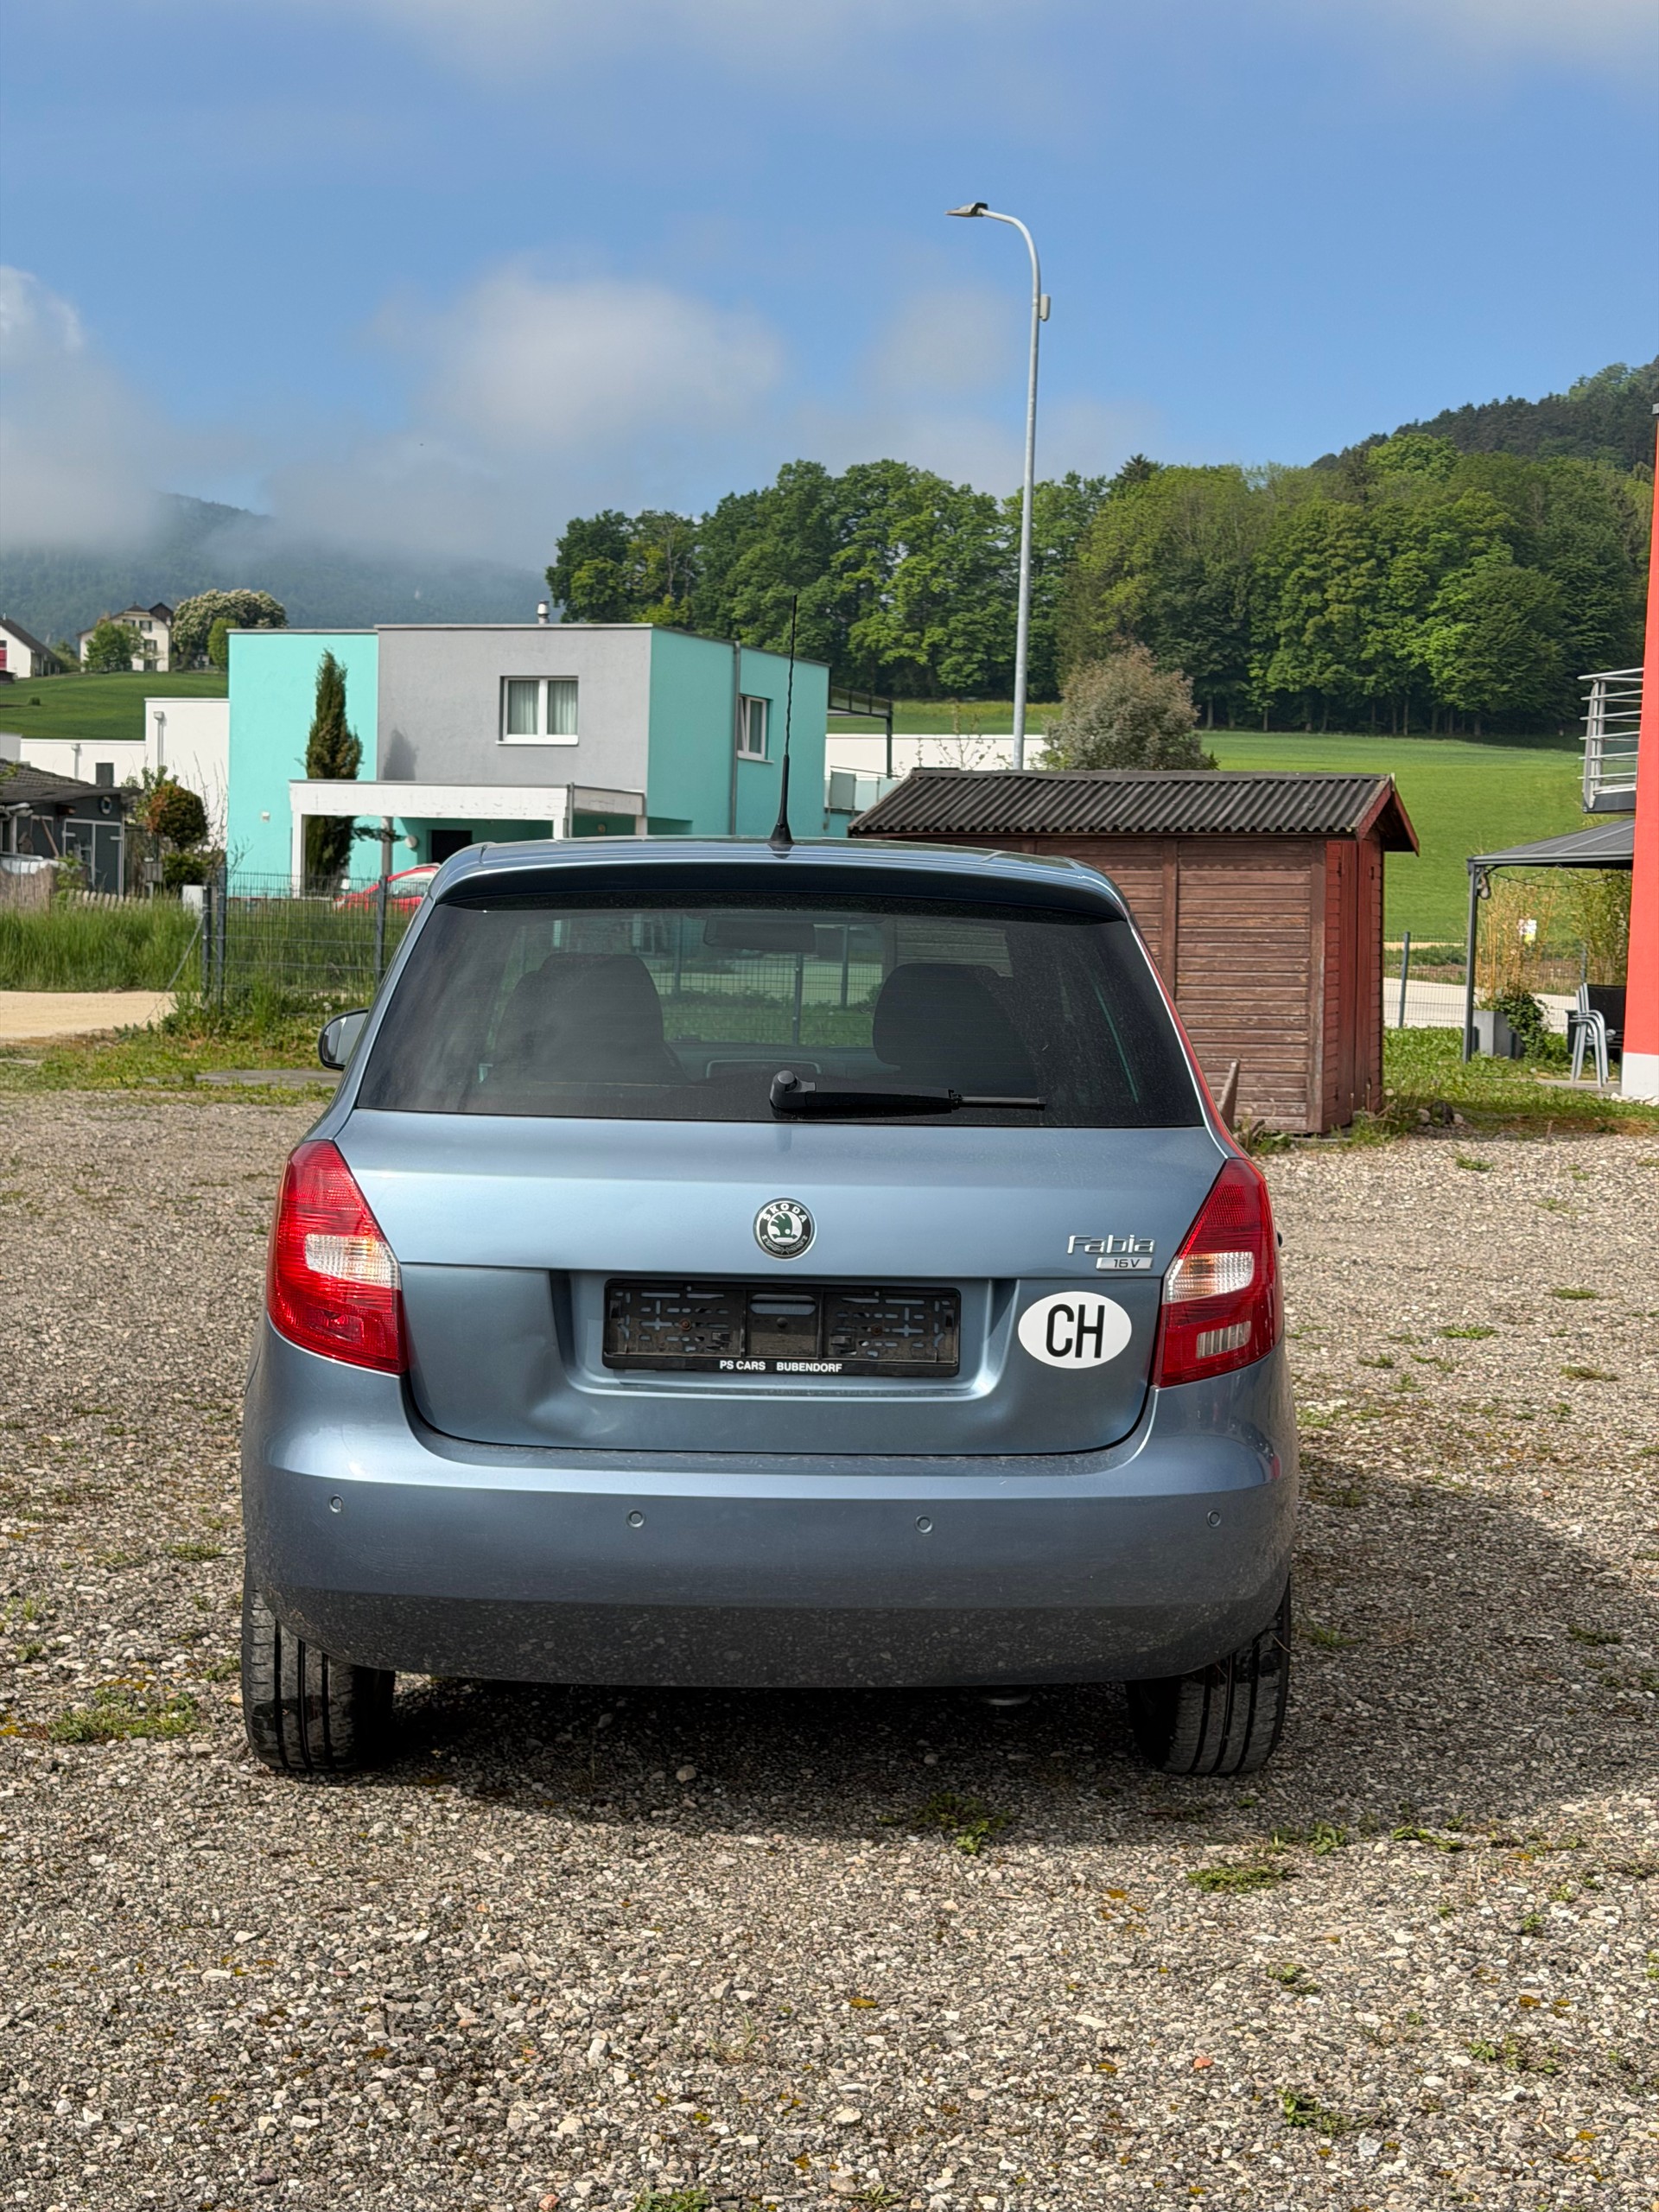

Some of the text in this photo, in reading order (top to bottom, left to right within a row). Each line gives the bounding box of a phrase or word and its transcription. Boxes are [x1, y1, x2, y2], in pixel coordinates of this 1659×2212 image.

[1067, 1235, 1155, 1255] Fabia
[1114, 1259, 1141, 1268] 16V
[1046, 1304, 1105, 1358] CH
[720, 1359, 843, 1372] PS CARS BUBENDORF
